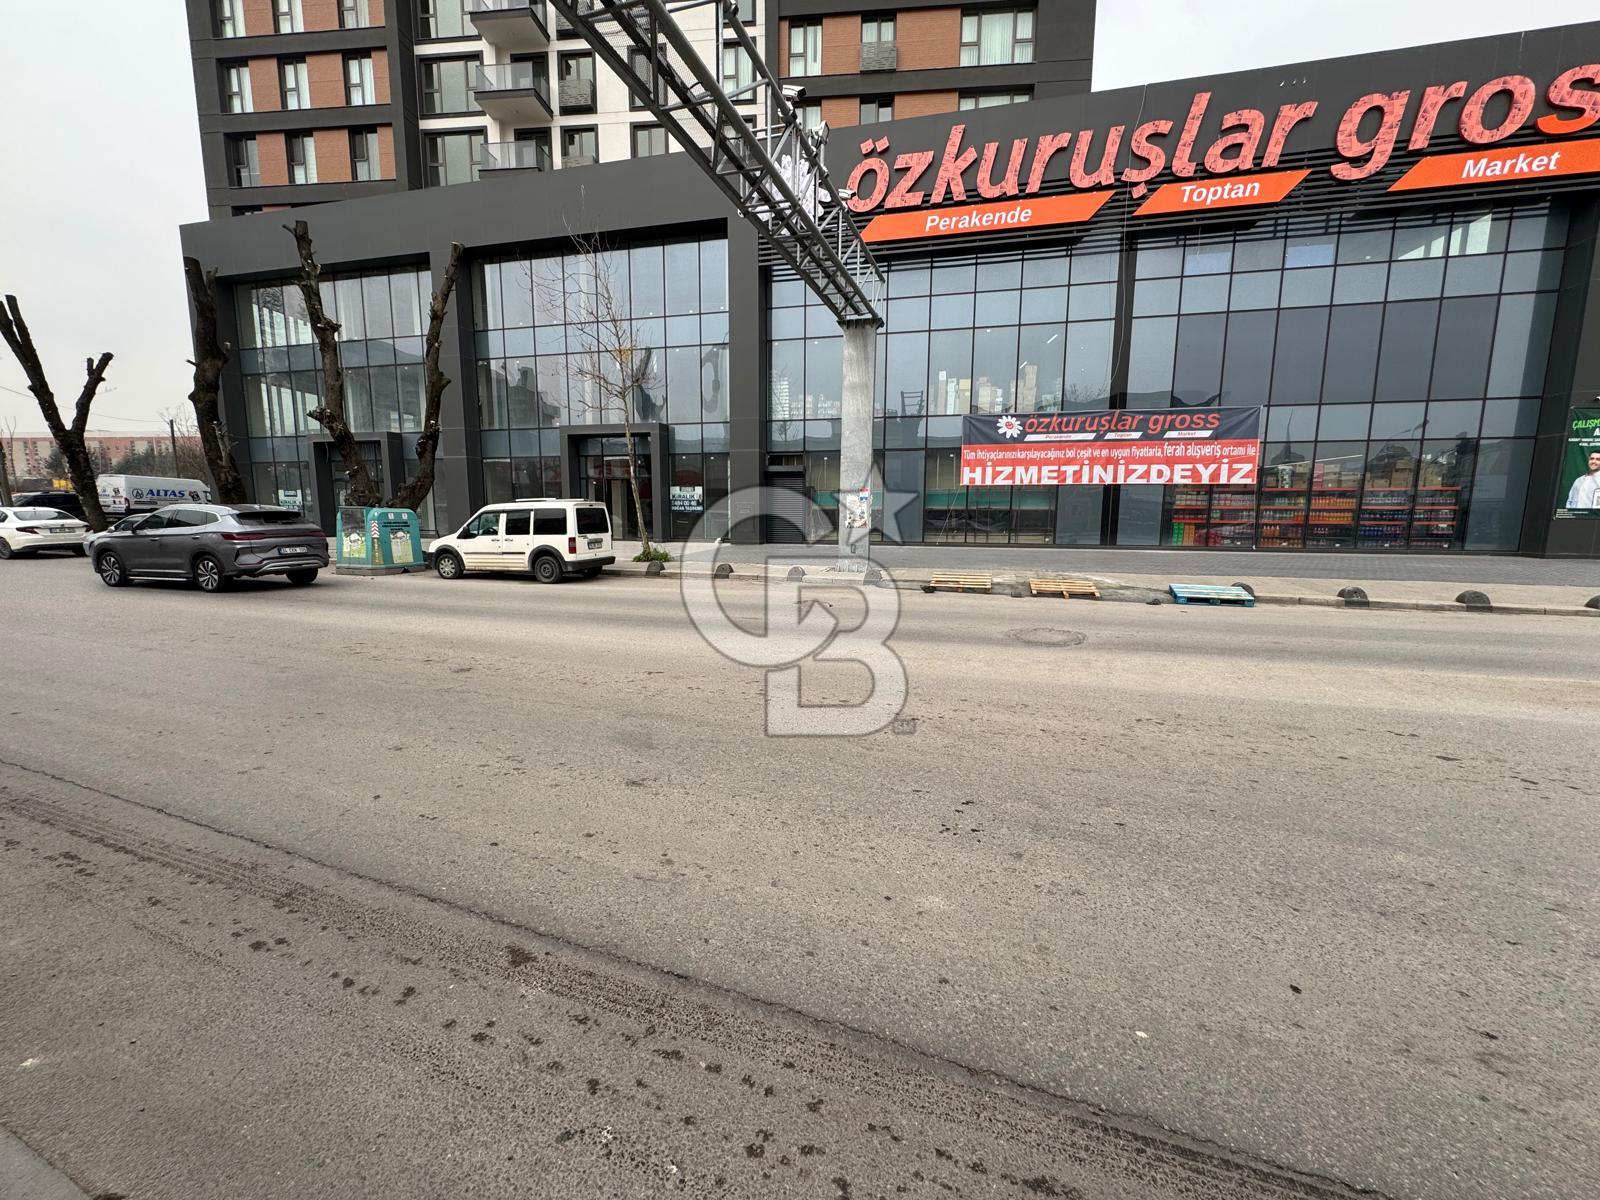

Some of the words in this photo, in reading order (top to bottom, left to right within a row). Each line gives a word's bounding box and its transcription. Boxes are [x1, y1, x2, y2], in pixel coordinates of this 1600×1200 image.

[846, 91, 1319, 213] özkuruşlar
[1461, 151, 1561, 178] Market
[1180, 182, 1261, 205] Toptan
[925, 206, 1032, 232] Perakende
[1024, 410, 1143, 434] özkuruşlar
[1148, 412, 1221, 434] gross
[964, 449, 975, 459] Tüm
[1066, 446, 1076, 458] bol
[1077, 447, 1091, 459] çeşit
[1093, 448, 1100, 457] ve
[1101, 448, 1109, 457] en
[1111, 447, 1130, 460] uygun
[1164, 442, 1185, 456] ferah
[1187, 441, 1222, 458] alışveriş
[1247, 443, 1256, 456] ile
[962, 458, 1253, 485] HİZMETİNİZDEYİZ
